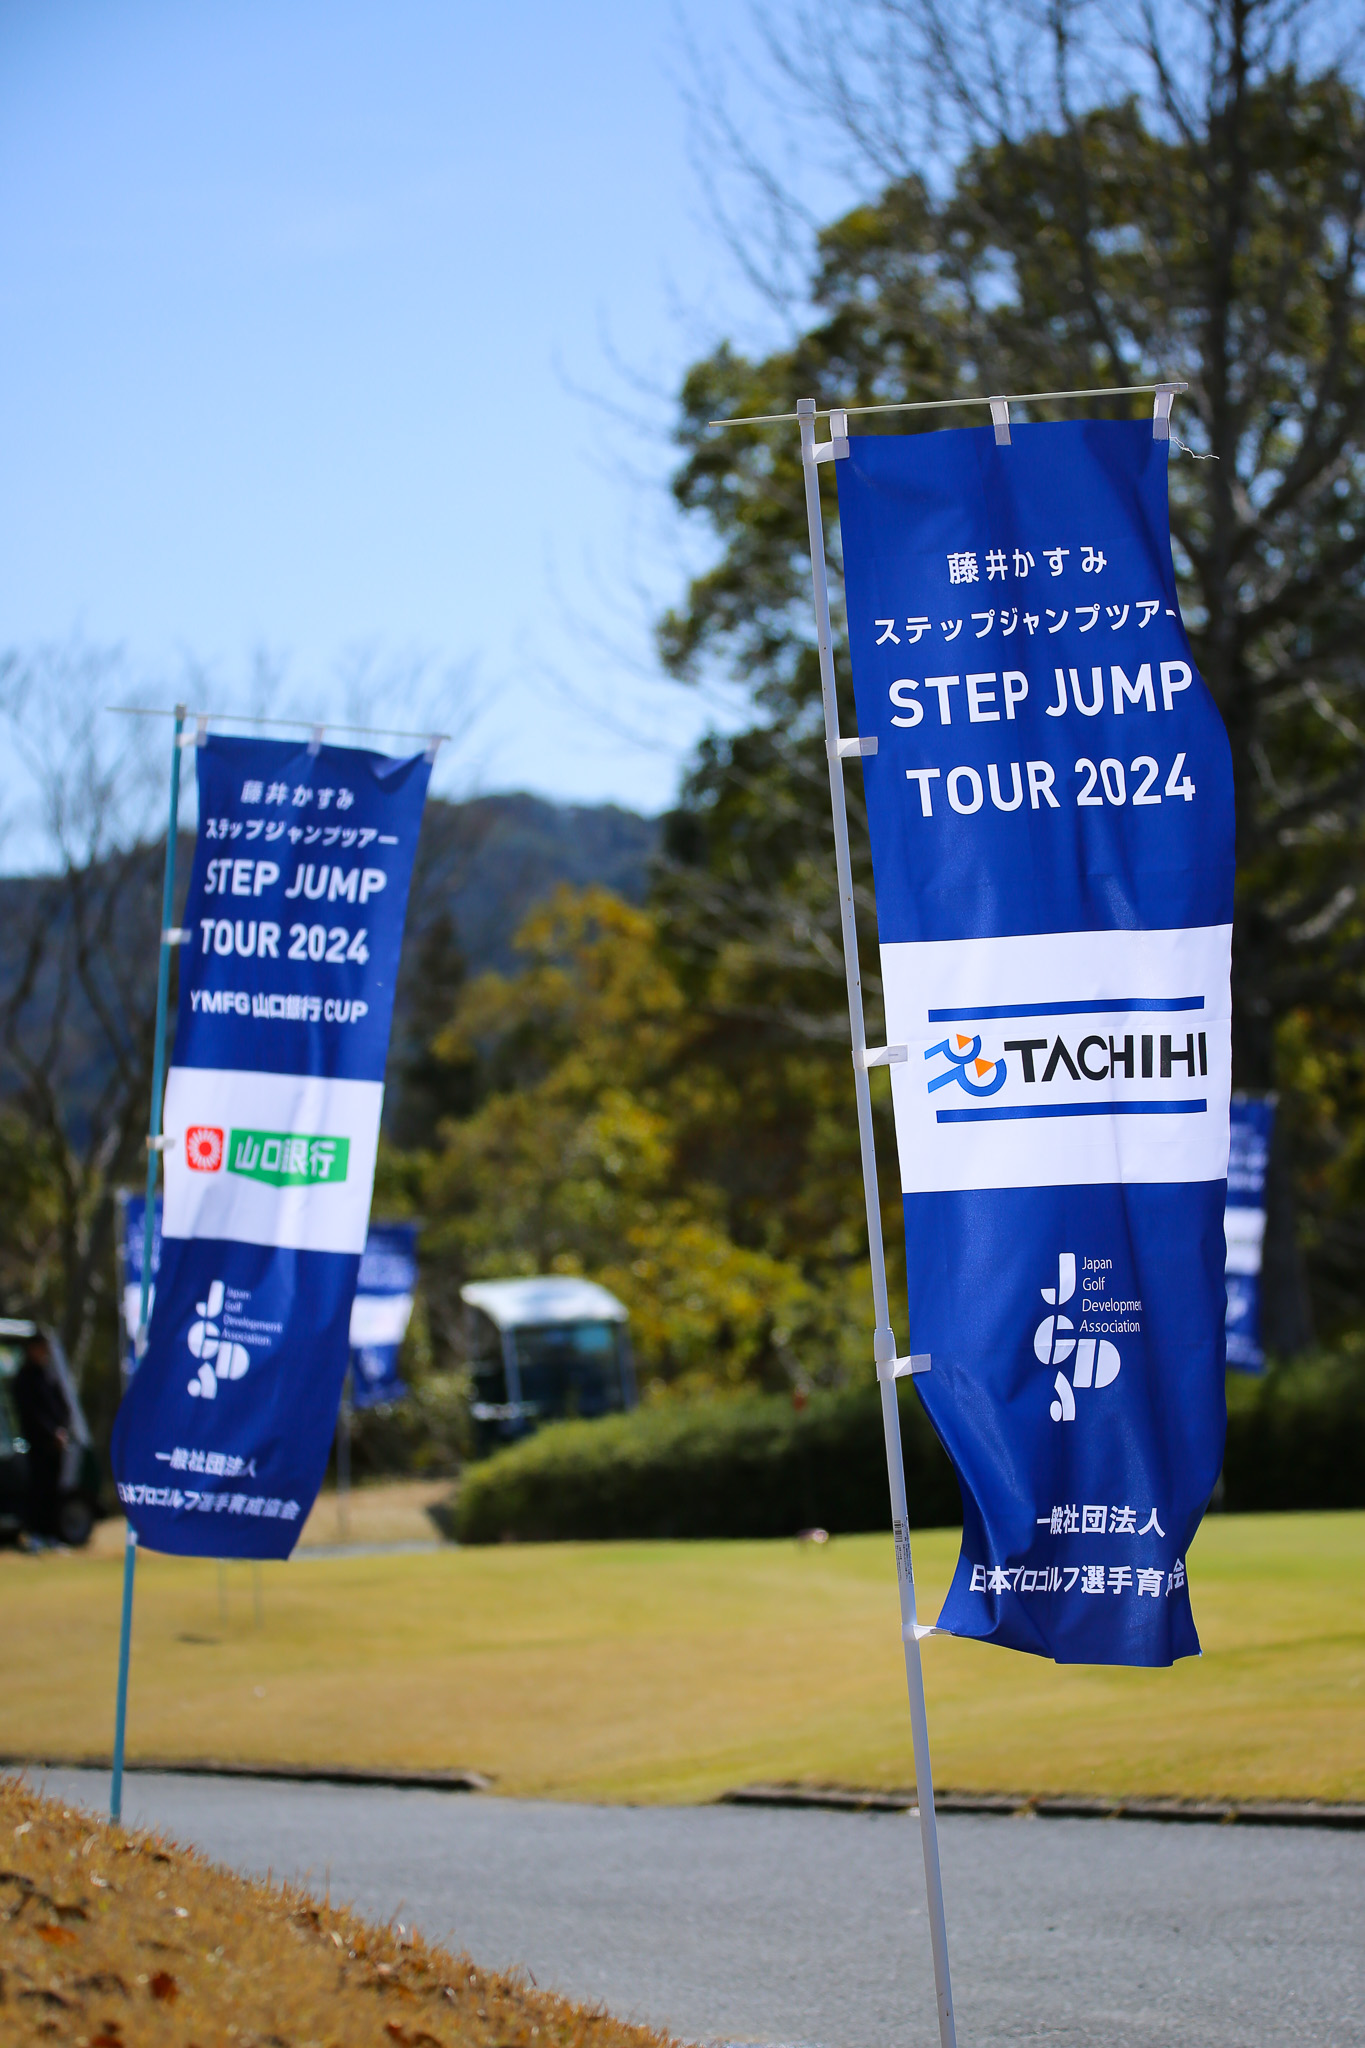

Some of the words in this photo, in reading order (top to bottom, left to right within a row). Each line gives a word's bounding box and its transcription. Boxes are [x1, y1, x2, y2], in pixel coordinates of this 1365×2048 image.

[946, 546, 1107, 584] 藤井かすみ
[888, 670, 1029, 728] STEP
[1045, 660, 1193, 717] JUMP
[240, 780, 354, 810] 藤井かすみ
[905, 761, 1060, 817] TOUR
[1074, 753, 1196, 806] 2024
[204, 858, 280, 897] STEP
[284, 863, 388, 904] JUMP
[200, 918, 281, 958] TOUR
[287, 923, 370, 965] 2024
[1004, 1031, 1208, 1083] TACHIHI
[235, 1136, 335, 1178] 山口銀行
[1081, 1256, 1113, 1273] Japan
[1082, 1276, 1106, 1291] Golf
[1079, 1319, 1141, 1333] Association
[1036, 1503, 1166, 1538] 一般社団法人
